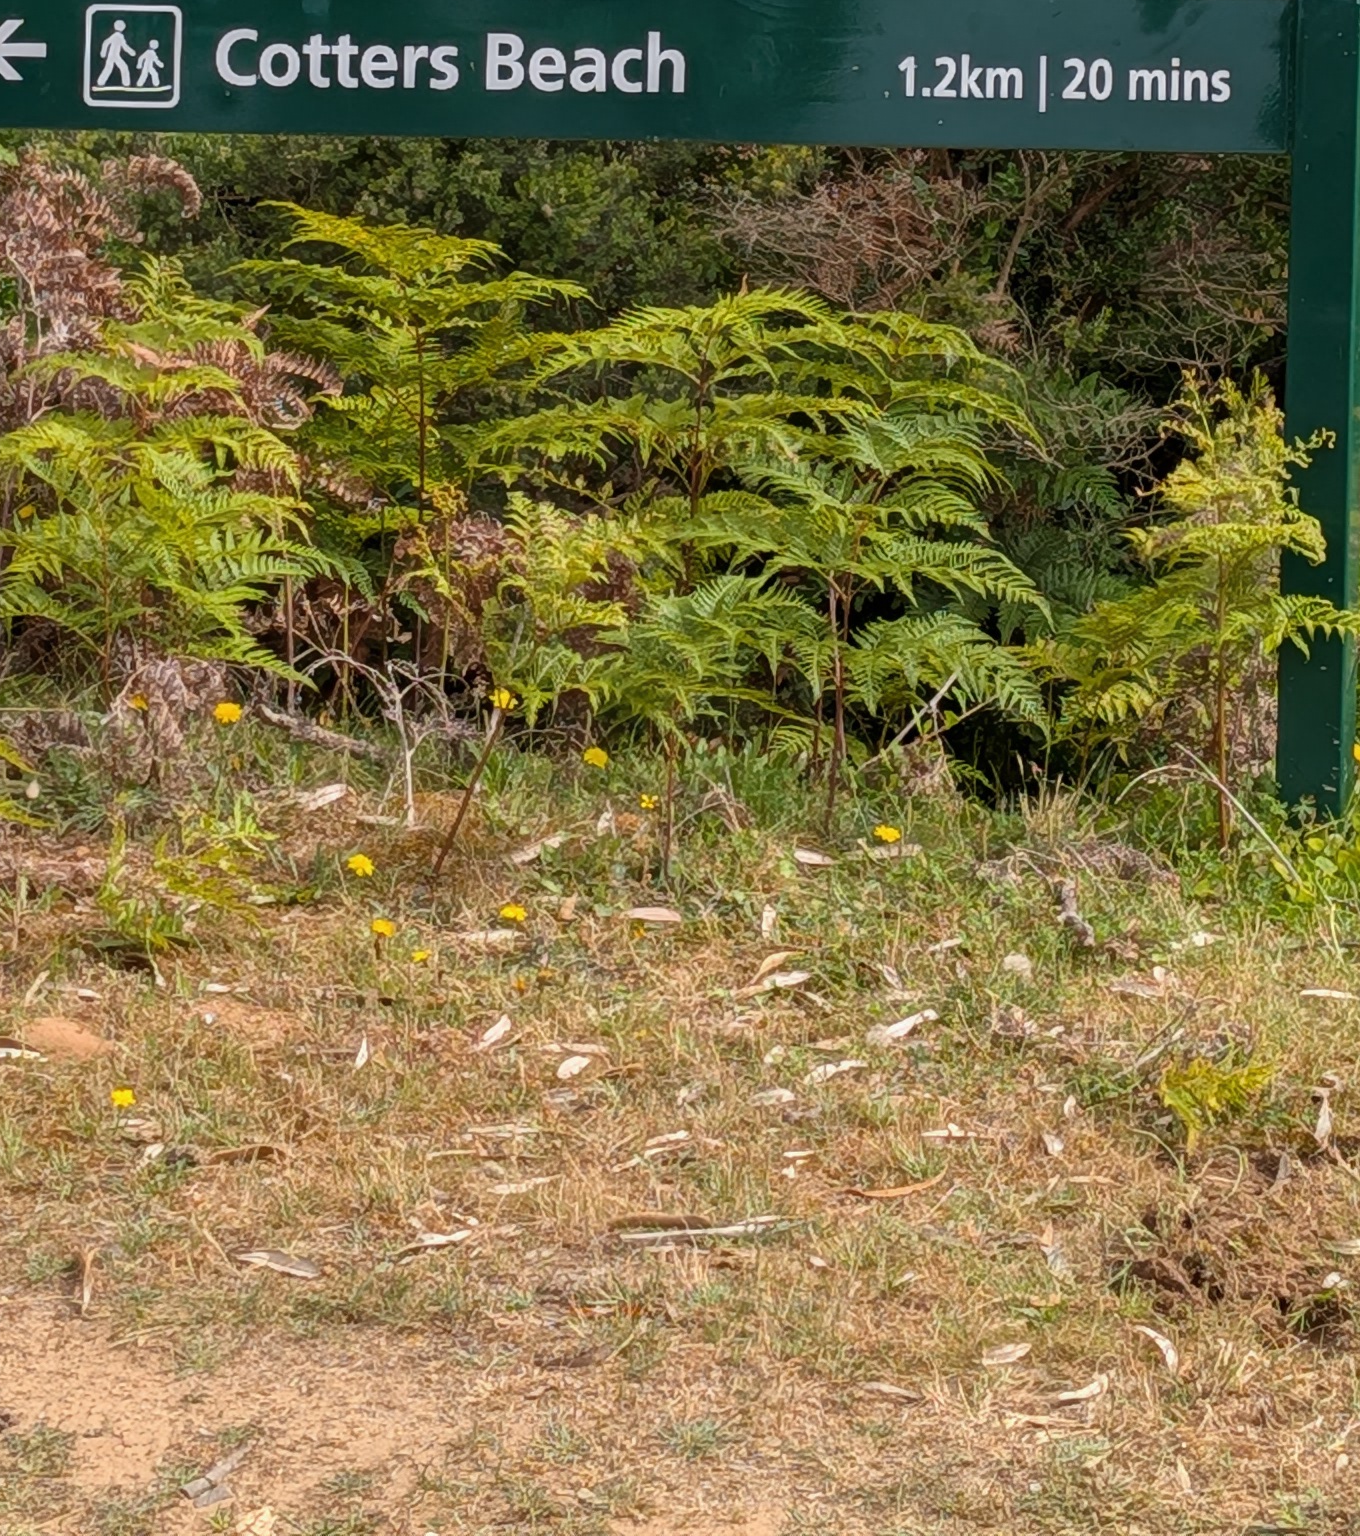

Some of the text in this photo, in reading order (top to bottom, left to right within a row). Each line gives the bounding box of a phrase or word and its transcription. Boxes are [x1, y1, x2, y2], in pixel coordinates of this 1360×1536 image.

[215, 28, 686, 93] Cotters Beach
[897, 55, 1023, 99] 1.2km
[1061, 57, 1113, 101] 20
[1128, 57, 1231, 103] mins
